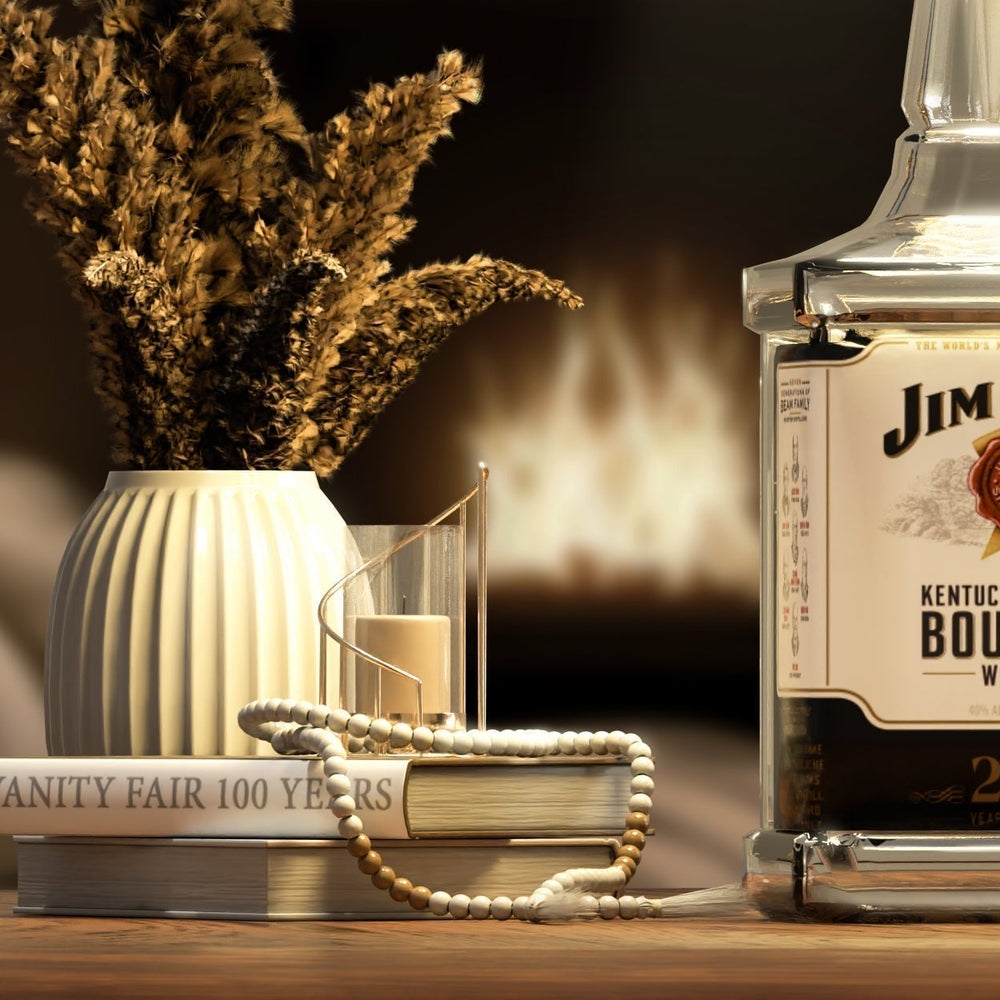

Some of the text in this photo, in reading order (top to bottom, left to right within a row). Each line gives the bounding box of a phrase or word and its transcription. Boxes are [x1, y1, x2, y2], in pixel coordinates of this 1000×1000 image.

[915, 341, 937, 350] THE
[883, 382, 995, 459] JIM
[125, 776, 206, 810] FAIR
[218, 778, 268, 810] 100
[280, 777, 392, 811] YERS
